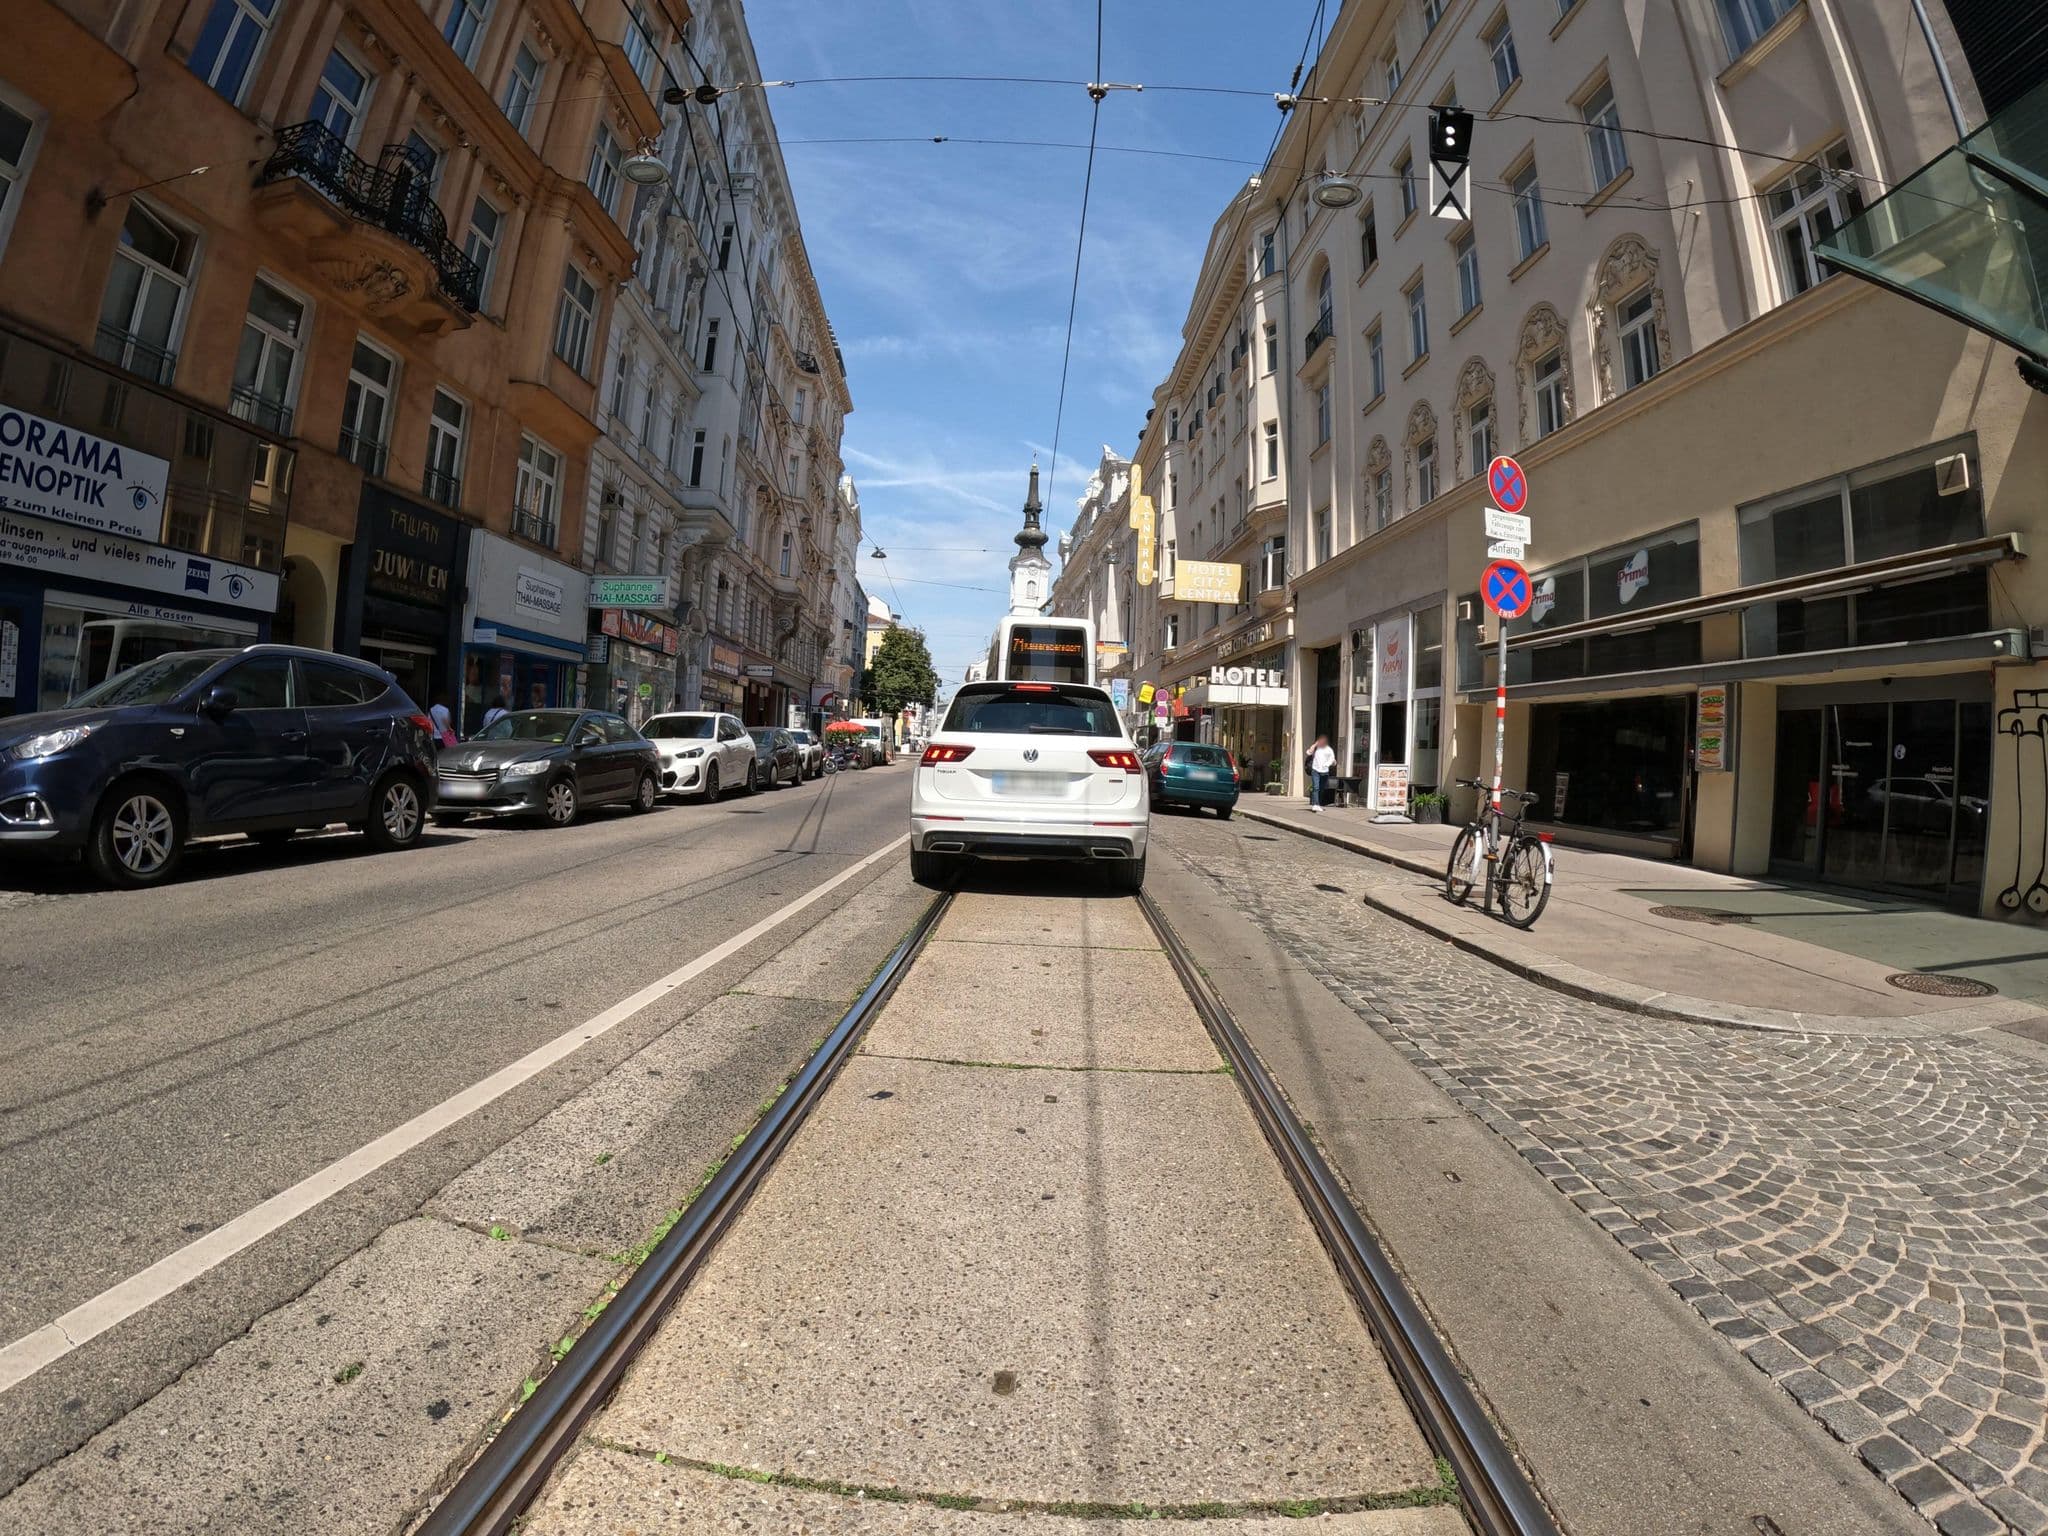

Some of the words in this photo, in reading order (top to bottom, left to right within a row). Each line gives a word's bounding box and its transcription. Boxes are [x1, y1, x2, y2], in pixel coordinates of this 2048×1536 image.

[13, 499, 47, 514] zum
[52, 506, 105, 527] kleinen
[109, 520, 143, 537] Preis
[27, 556, 37, 564] 00
[71, 537, 98, 553] und
[104, 543, 141, 562] vieles
[146, 554, 177, 571] mehr
[187, 567, 209, 580] ZEISS
[1187, 563, 1233, 577] HOTEL
[602, 581, 653, 592] Suphannee
[516, 592, 561, 613] THAI-MASSAGE
[590, 593, 665, 604] THAI-MASSAGE
[1179, 588, 1239, 603] CENTRAL
[128, 602, 150, 617] Alle
[155, 607, 194, 623] Kassen
[1013, 638, 1024, 652] 71
[1210, 665, 1280, 687] HOTEL
